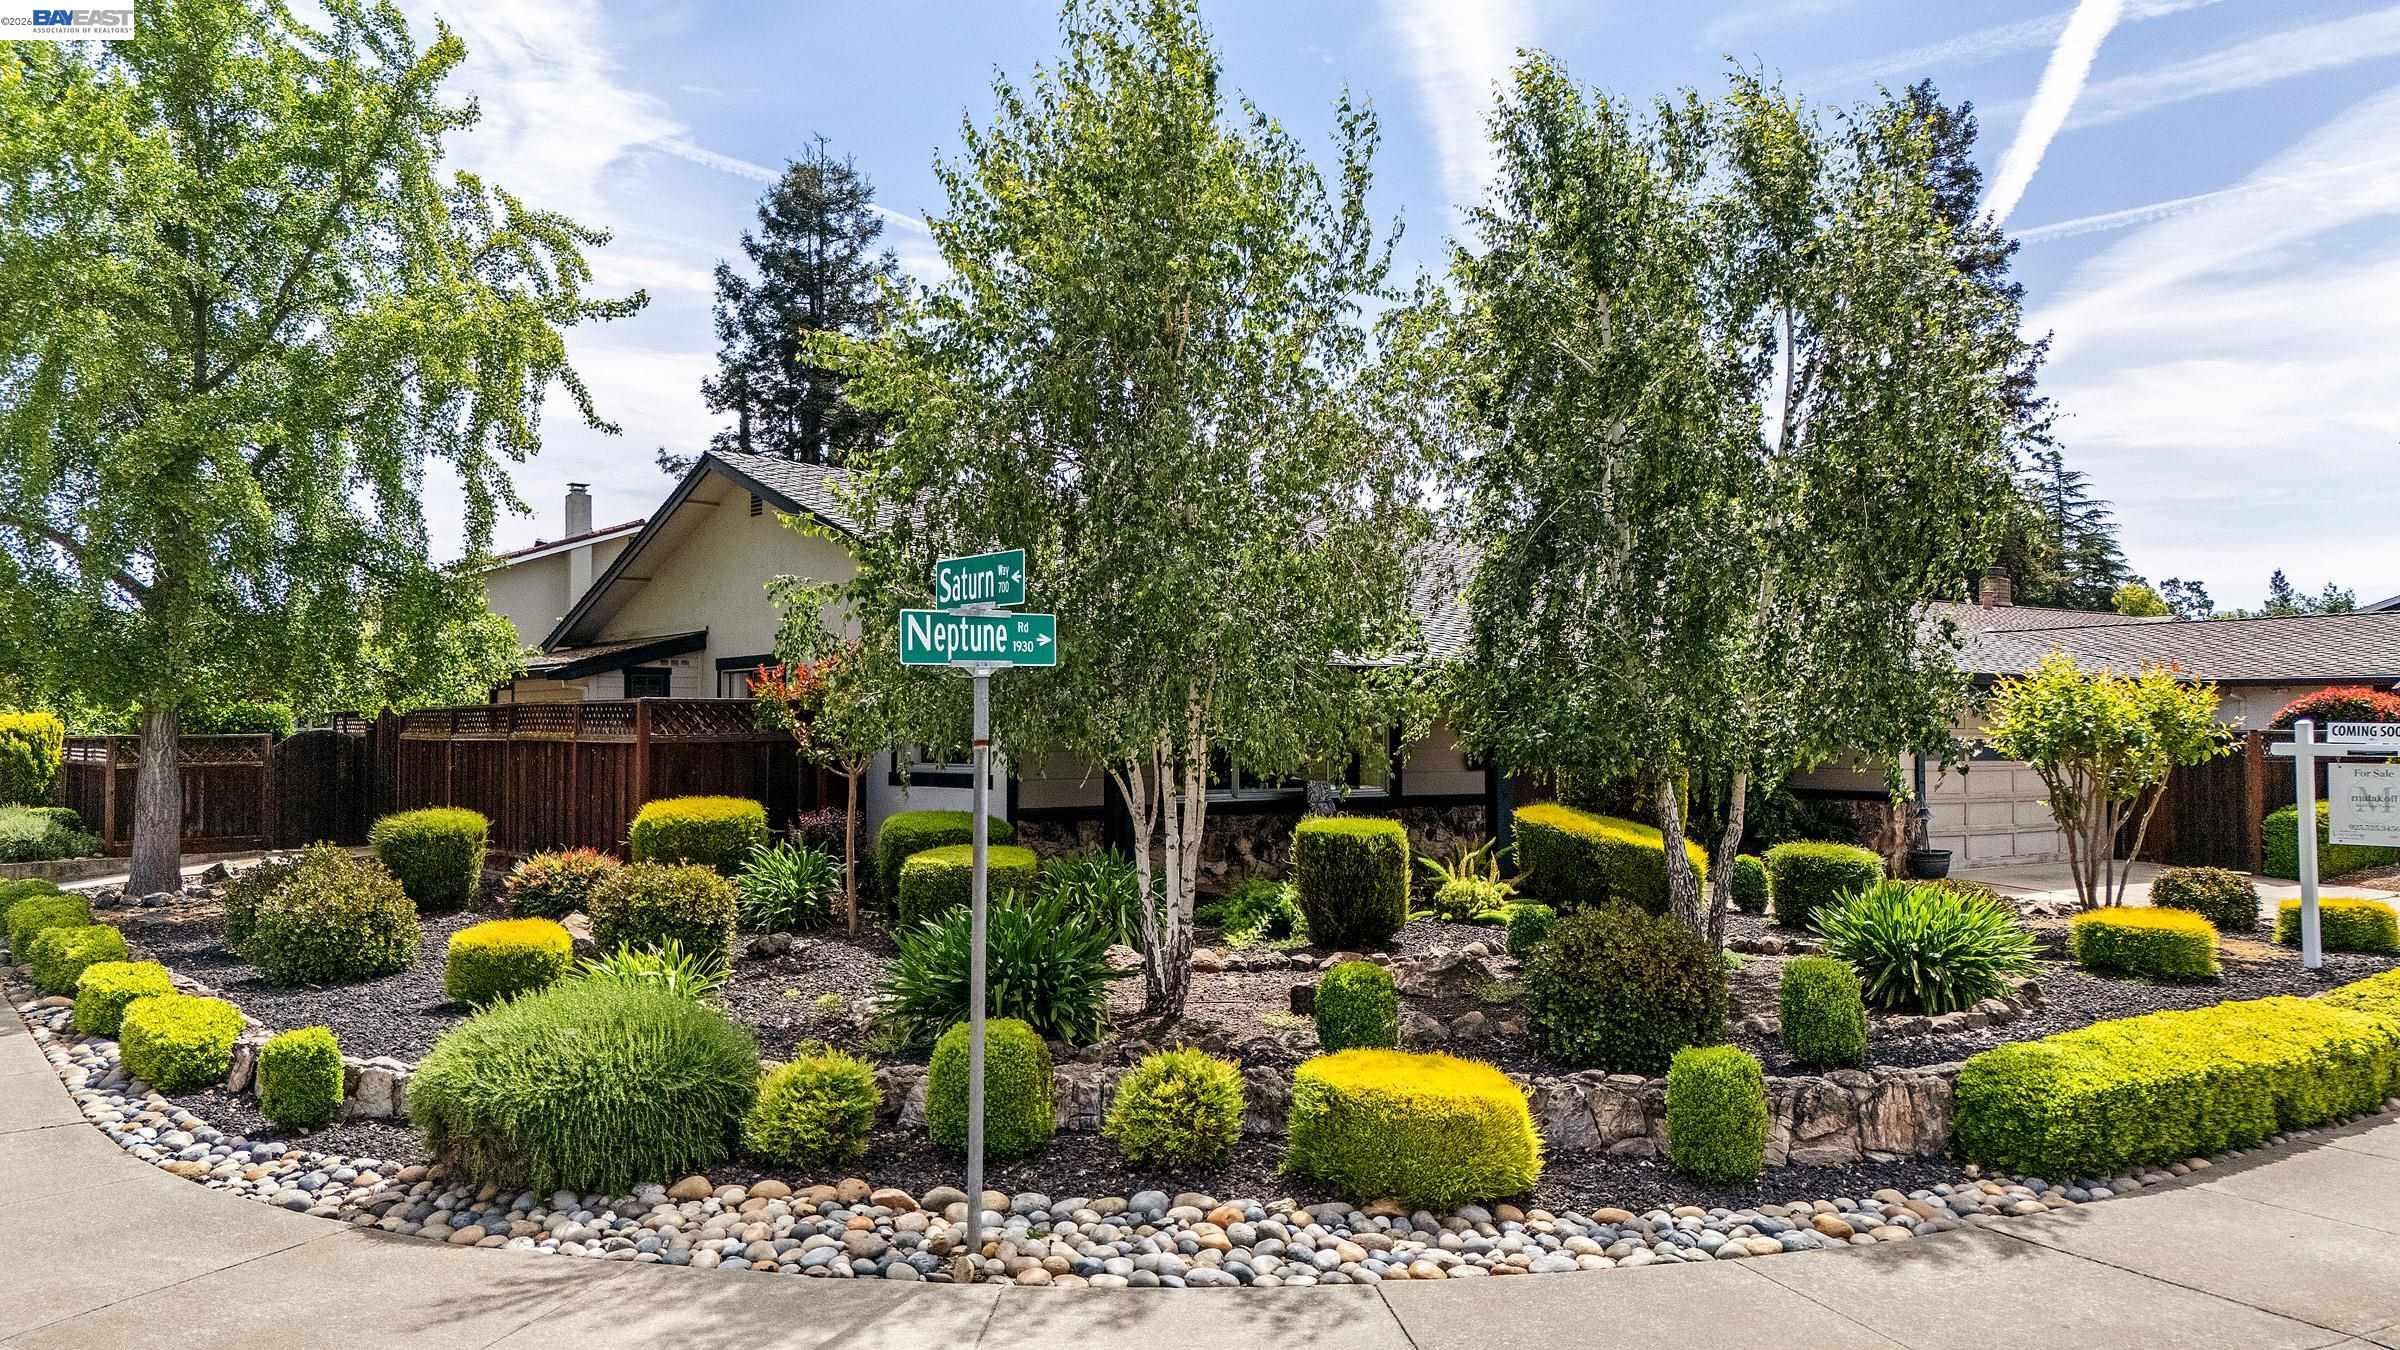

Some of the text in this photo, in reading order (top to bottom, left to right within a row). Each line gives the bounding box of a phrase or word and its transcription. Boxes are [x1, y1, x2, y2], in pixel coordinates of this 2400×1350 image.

[940, 565, 1010, 603] Saturn Way
[998, 581, 1010, 593] 700
[907, 614, 1029, 661] Neptune Rd
[1013, 641, 1034, 653] 1930
[2332, 725, 2377, 737] COMING
[2354, 768, 2395, 778] For Sale
